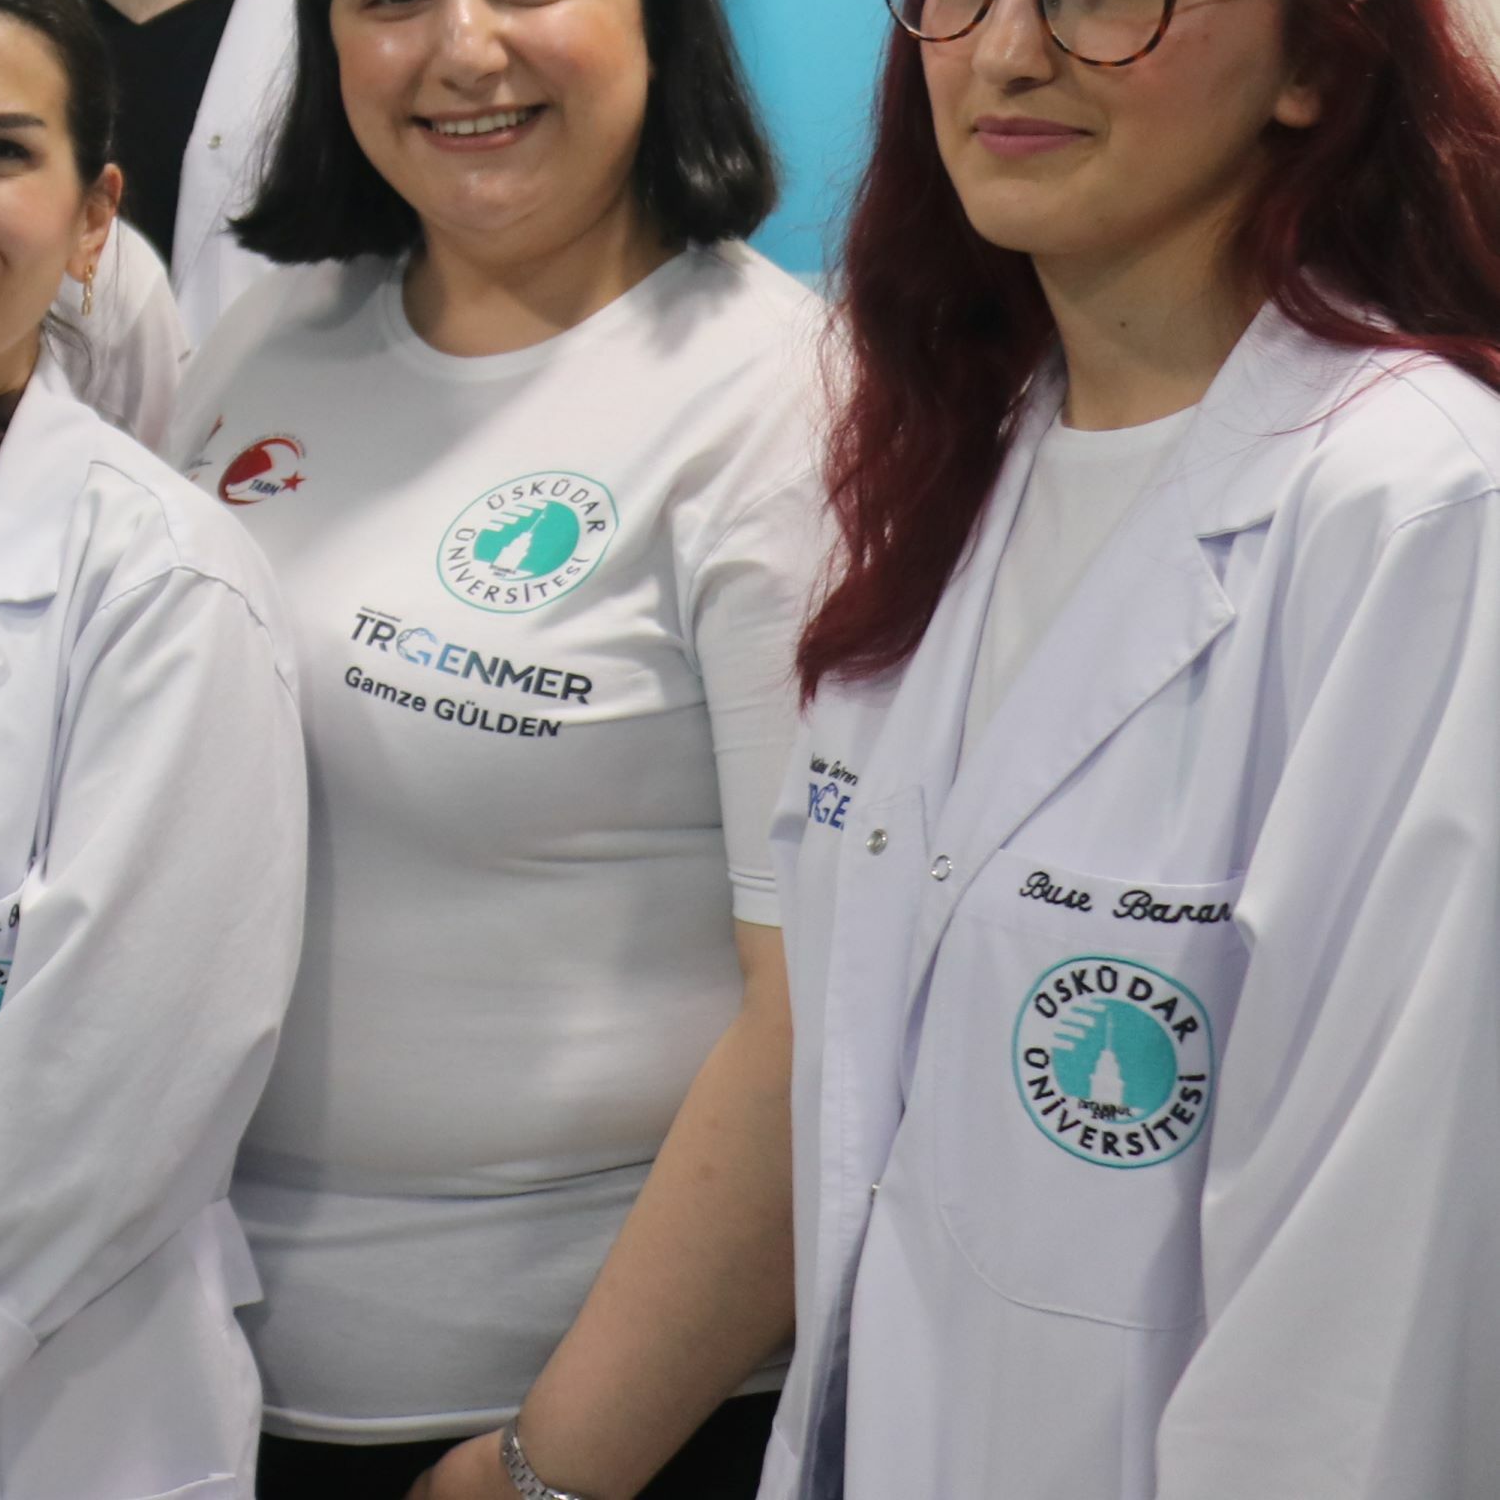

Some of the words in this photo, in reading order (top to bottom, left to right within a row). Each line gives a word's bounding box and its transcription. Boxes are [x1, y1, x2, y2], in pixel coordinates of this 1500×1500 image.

[350, 612, 593, 705] TRGENMER
[344, 665, 427, 713] Gamze
[433, 698, 562, 738] GÜLDEN
[1019, 871, 1093, 912] Buse
